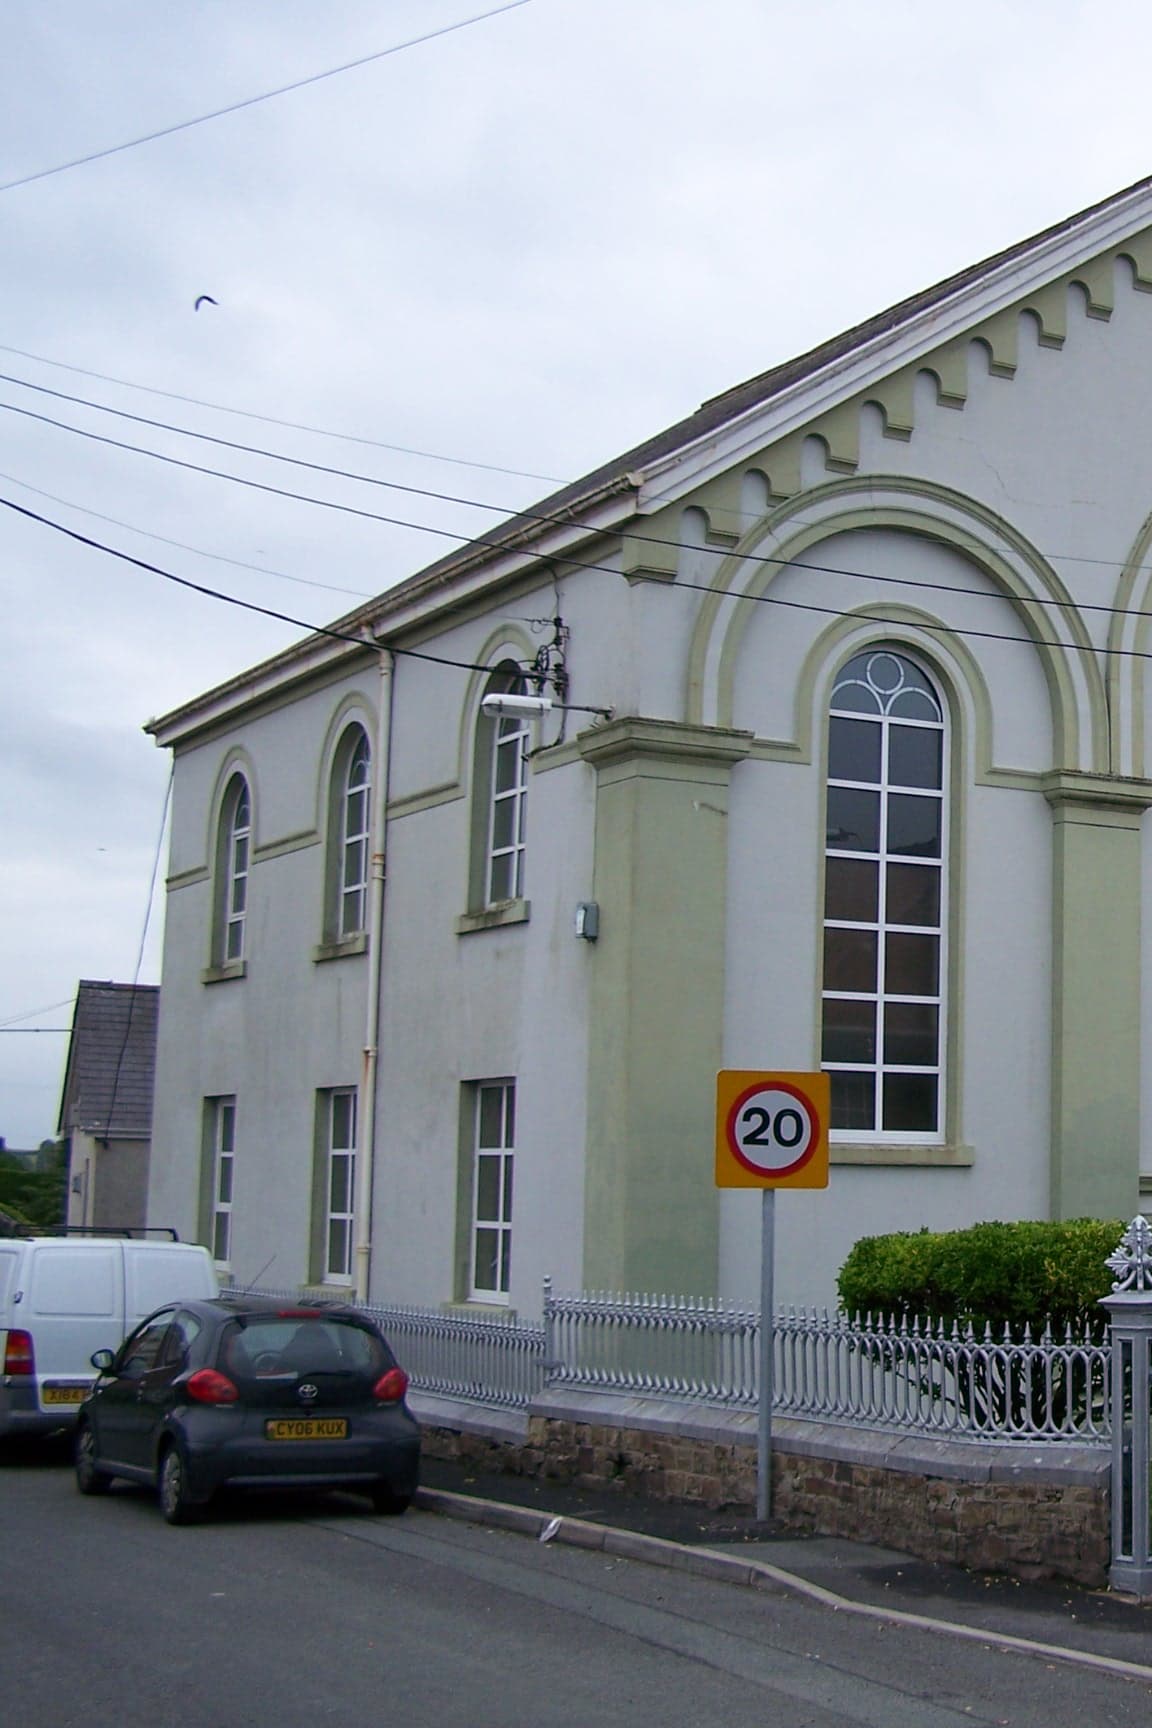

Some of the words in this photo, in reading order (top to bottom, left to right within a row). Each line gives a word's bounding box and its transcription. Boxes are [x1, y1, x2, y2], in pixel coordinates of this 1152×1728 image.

[742, 1107, 804, 1148] 20
[276, 1422, 313, 1436] CY06
[317, 1421, 344, 1435] KUX
